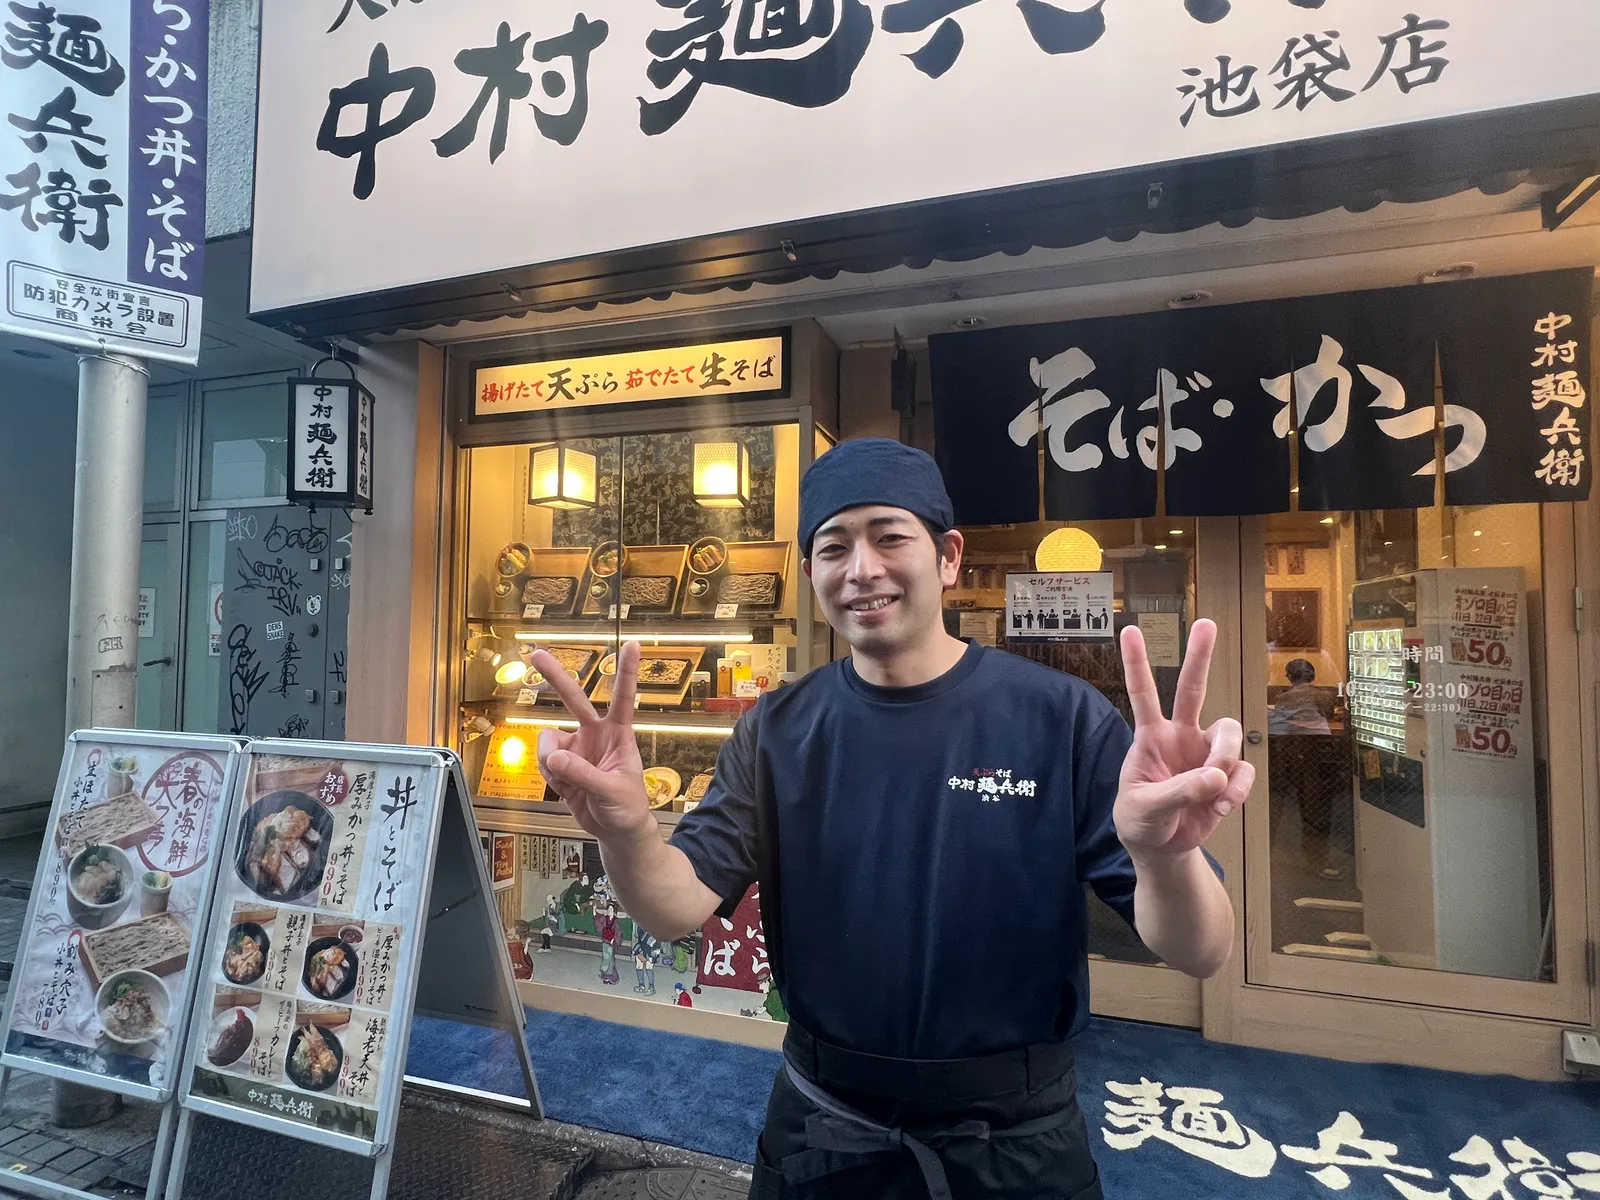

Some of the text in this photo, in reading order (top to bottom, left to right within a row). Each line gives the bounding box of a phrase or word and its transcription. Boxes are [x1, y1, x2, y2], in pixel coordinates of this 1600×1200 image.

[1175, 14, 1451, 129] 池袋店
[0, 1, 126, 251] 麺兵衛
[23, 282, 175, 328] 防犯カメラ設置
[56, 278, 151, 308] 安全な街宣言
[1007, 333, 1487, 477] そば・かつ
[1530, 311, 1586, 486] 中村麺兵衛
[305, 384, 338, 489] 中村麺兵衛
[1029, 577, 1091, 586] セルフサービス
[76, 760, 97, 829] 生ほたて
[165, 760, 207, 869] 春の海鮮
[319, 771, 337, 805] おすすめ
[947, 775, 1038, 798] 中村麺兵衛
[332, 773, 367, 905] 厚みかつ丼とそば
[373, 775, 418, 912] 丼とそば
[56, 943, 78, 1015] 刻み穴子
[275, 913, 299, 991] 親子丼とそば
[376, 935, 394, 1004] 厚みかつ丼と
[257, 1051, 267, 1077] そば
[346, 1071, 358, 1098] そば
[356, 1017, 380, 1096] 海老天丼と
[247, 1088, 314, 1119] 中村麺兵衛
